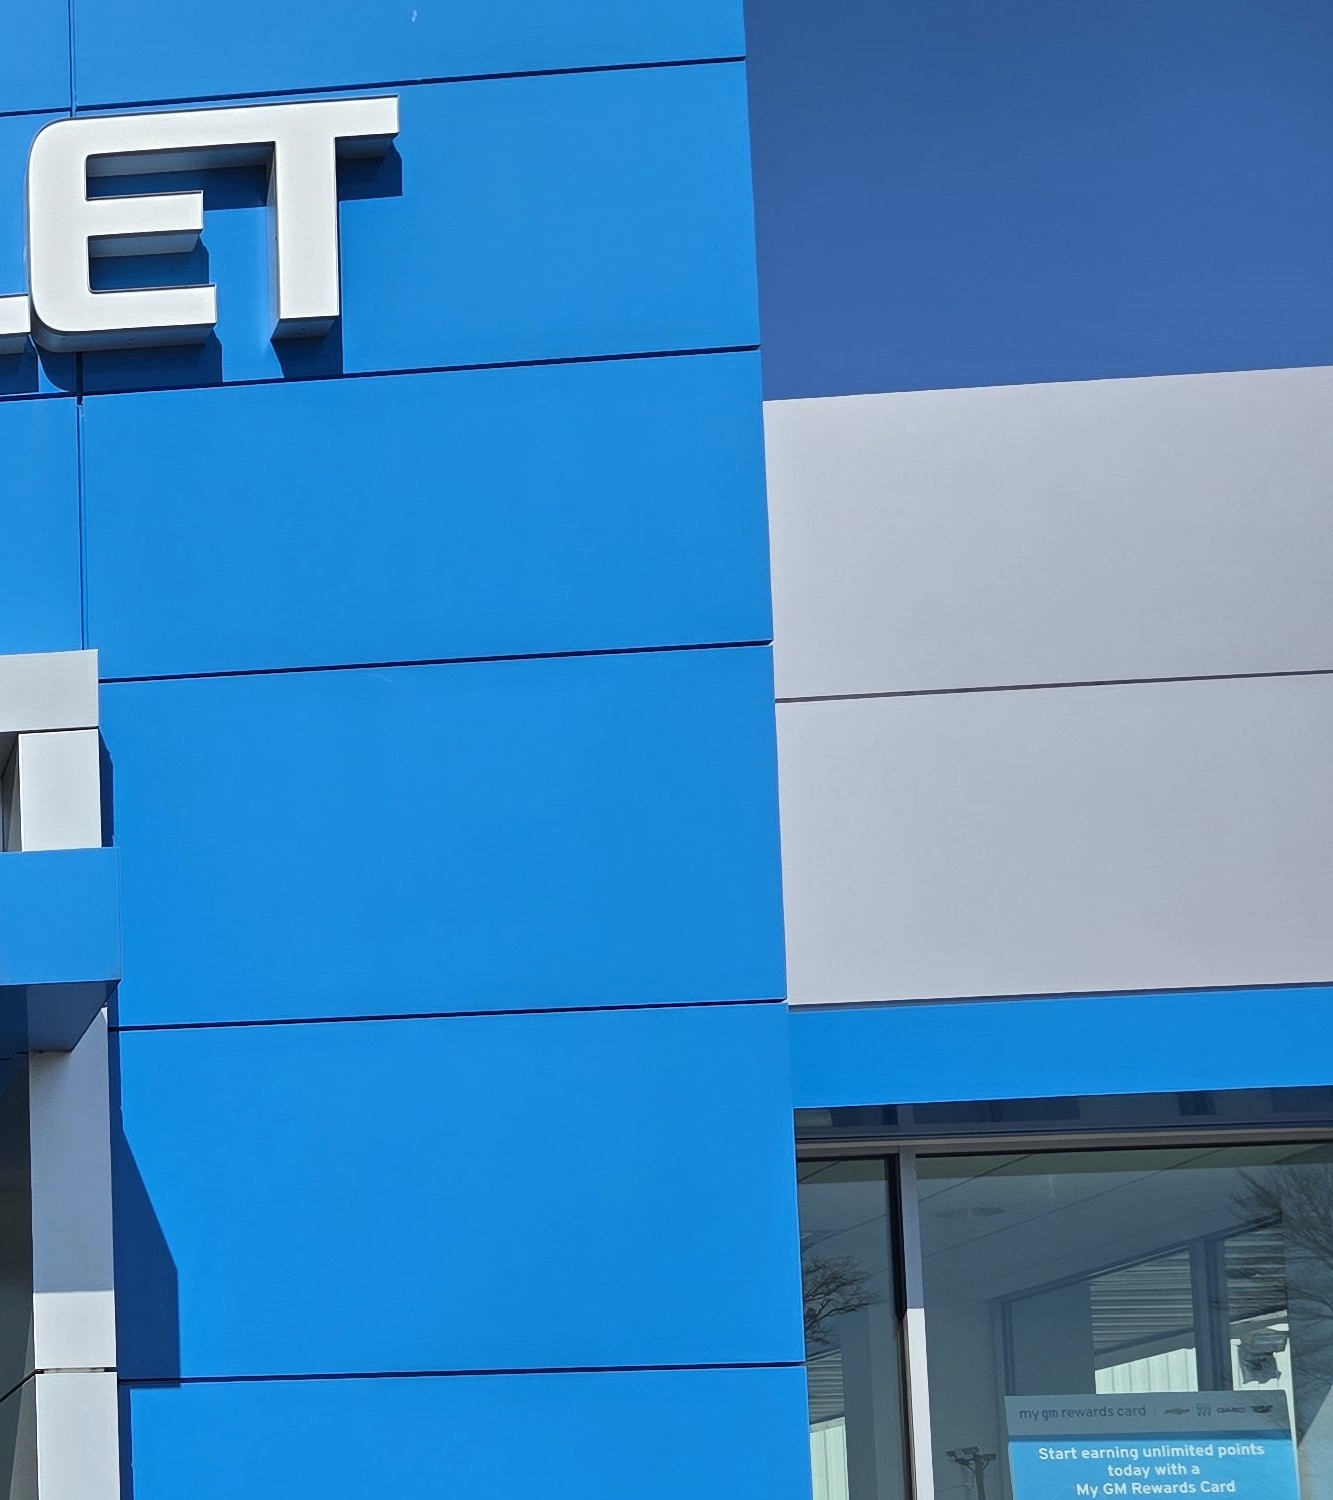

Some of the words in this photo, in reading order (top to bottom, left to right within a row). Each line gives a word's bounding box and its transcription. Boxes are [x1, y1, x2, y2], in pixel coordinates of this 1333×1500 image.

[1019, 1408, 1039, 1421] my
[1042, 1409, 1058, 1421] gm
[1061, 1405, 1114, 1418] rewards
[1117, 1406, 1146, 1417] card
[1038, 1447, 1077, 1460] Start
[1081, 1446, 1139, 1461] earning
[1142, 1444, 1213, 1458] unlimited
[1218, 1443, 1265, 1458] points
[1107, 1464, 1150, 1478] today
[1154, 1463, 1187, 1476] with
[1191, 1466, 1200, 1475] a
[1077, 1483, 1098, 1498] My
[1102, 1483, 1127, 1494] GM
[1131, 1481, 1196, 1494] Rewards
[1200, 1480, 1235, 1493] Card
